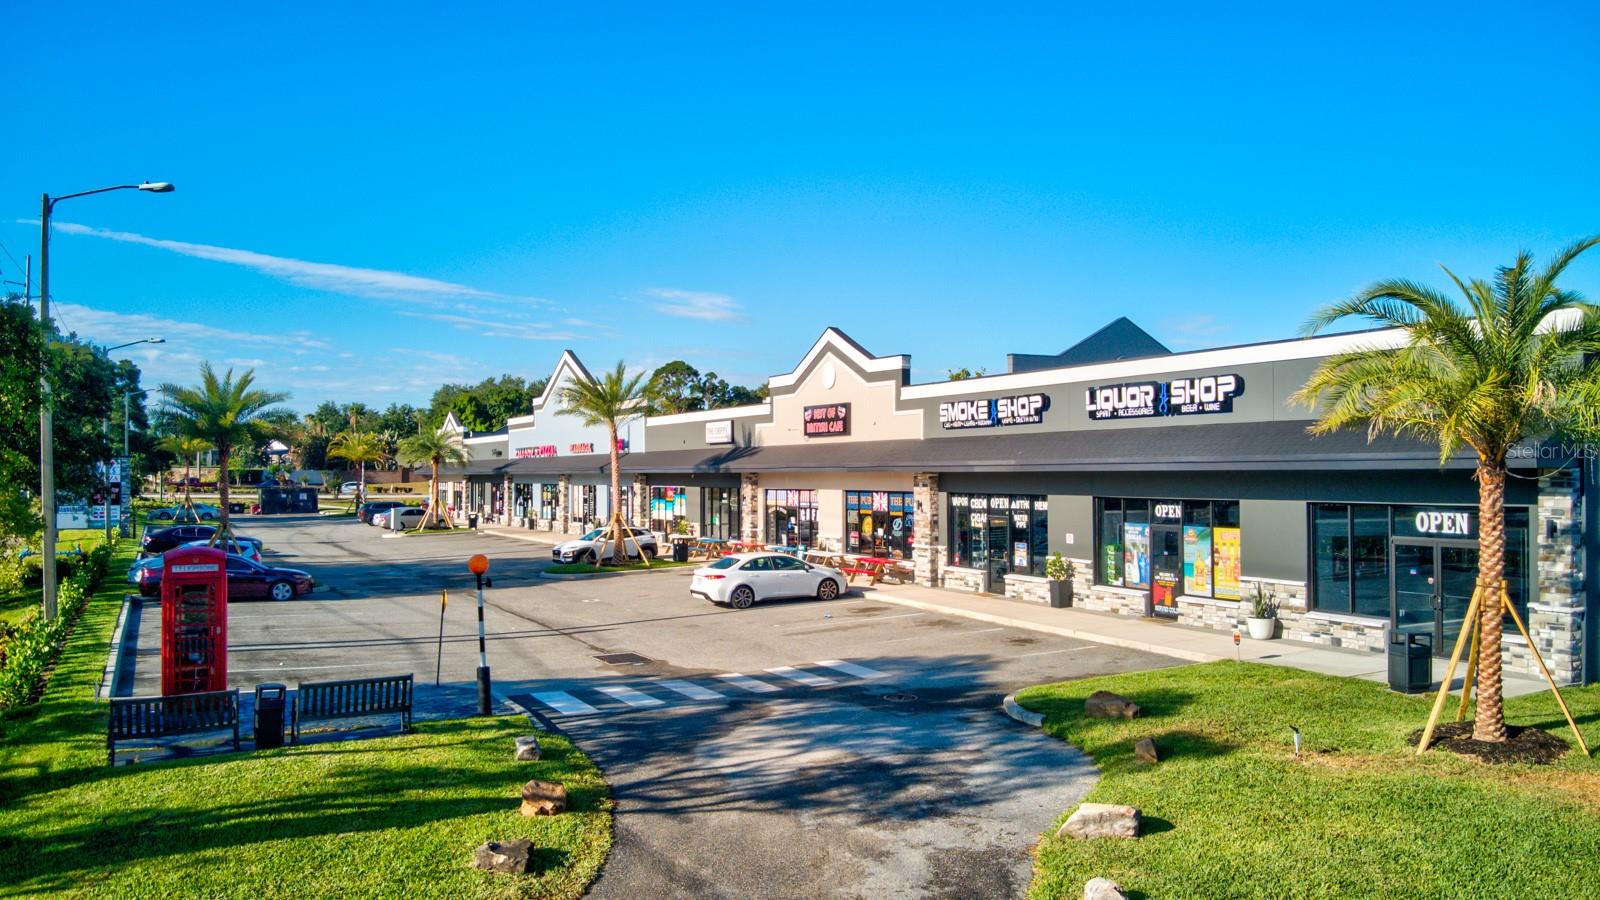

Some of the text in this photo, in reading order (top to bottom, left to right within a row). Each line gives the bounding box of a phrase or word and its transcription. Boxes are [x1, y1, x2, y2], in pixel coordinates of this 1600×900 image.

[1085, 375, 1236, 410] LIQUOR SHOP
[939, 395, 1043, 422] SMOKE SHOP
[1181, 402, 1220, 413] BEER WINE
[905, 496, 914, 505] PU
[952, 496, 969, 507] VAPOR
[990, 497, 1009, 509] OPEN
[1154, 504, 1181, 518] OPEN
[1415, 511, 1469, 535] OPEN
